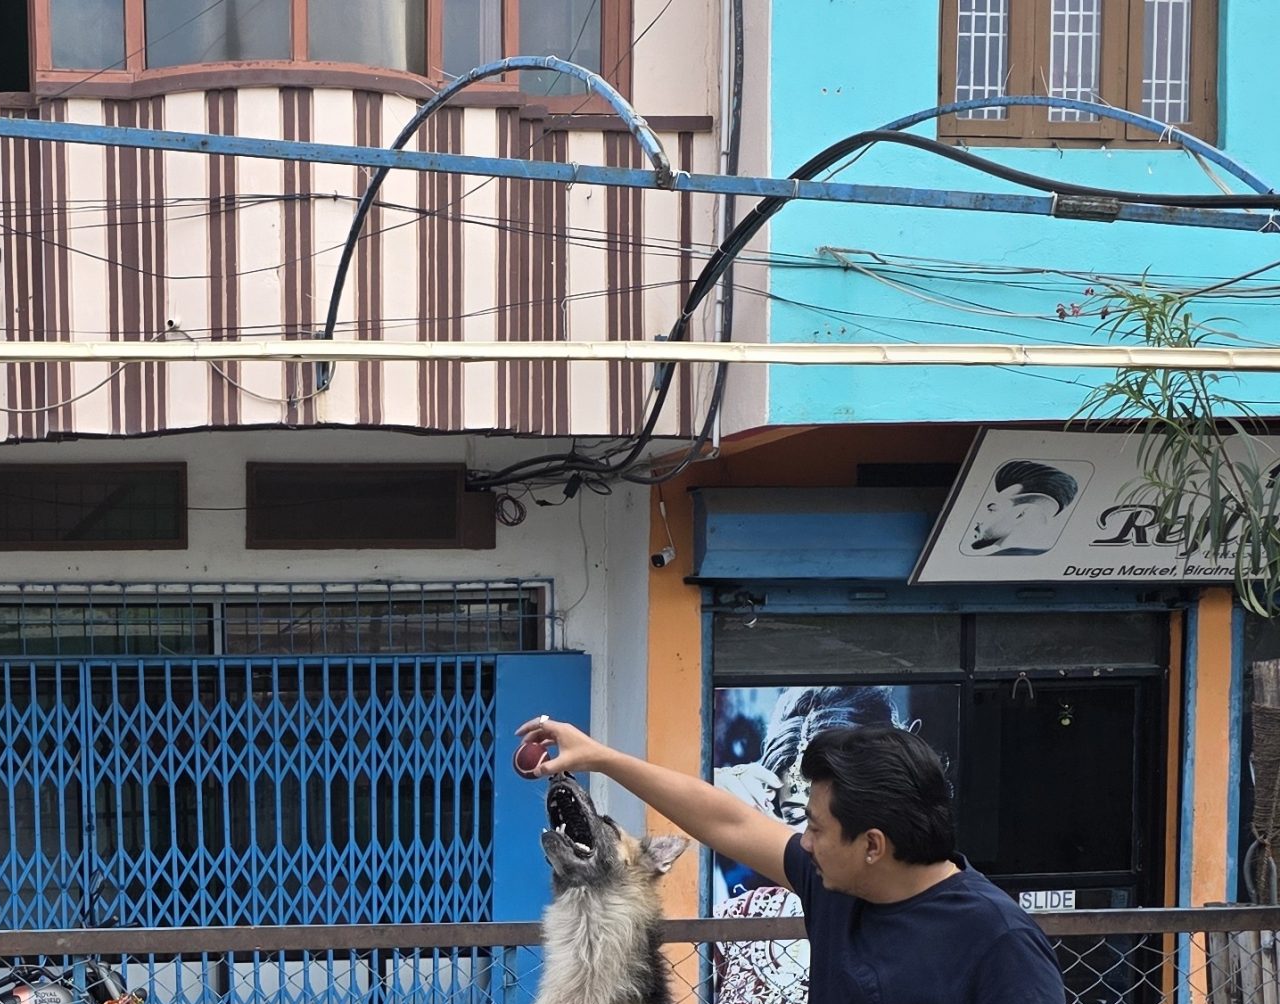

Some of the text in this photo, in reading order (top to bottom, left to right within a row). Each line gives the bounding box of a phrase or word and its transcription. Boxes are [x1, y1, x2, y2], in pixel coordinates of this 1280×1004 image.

[1063, 565, 1114, 578] Durga
[1117, 565, 1177, 577] Market,
[1021, 891, 1073, 909] SLIDE
